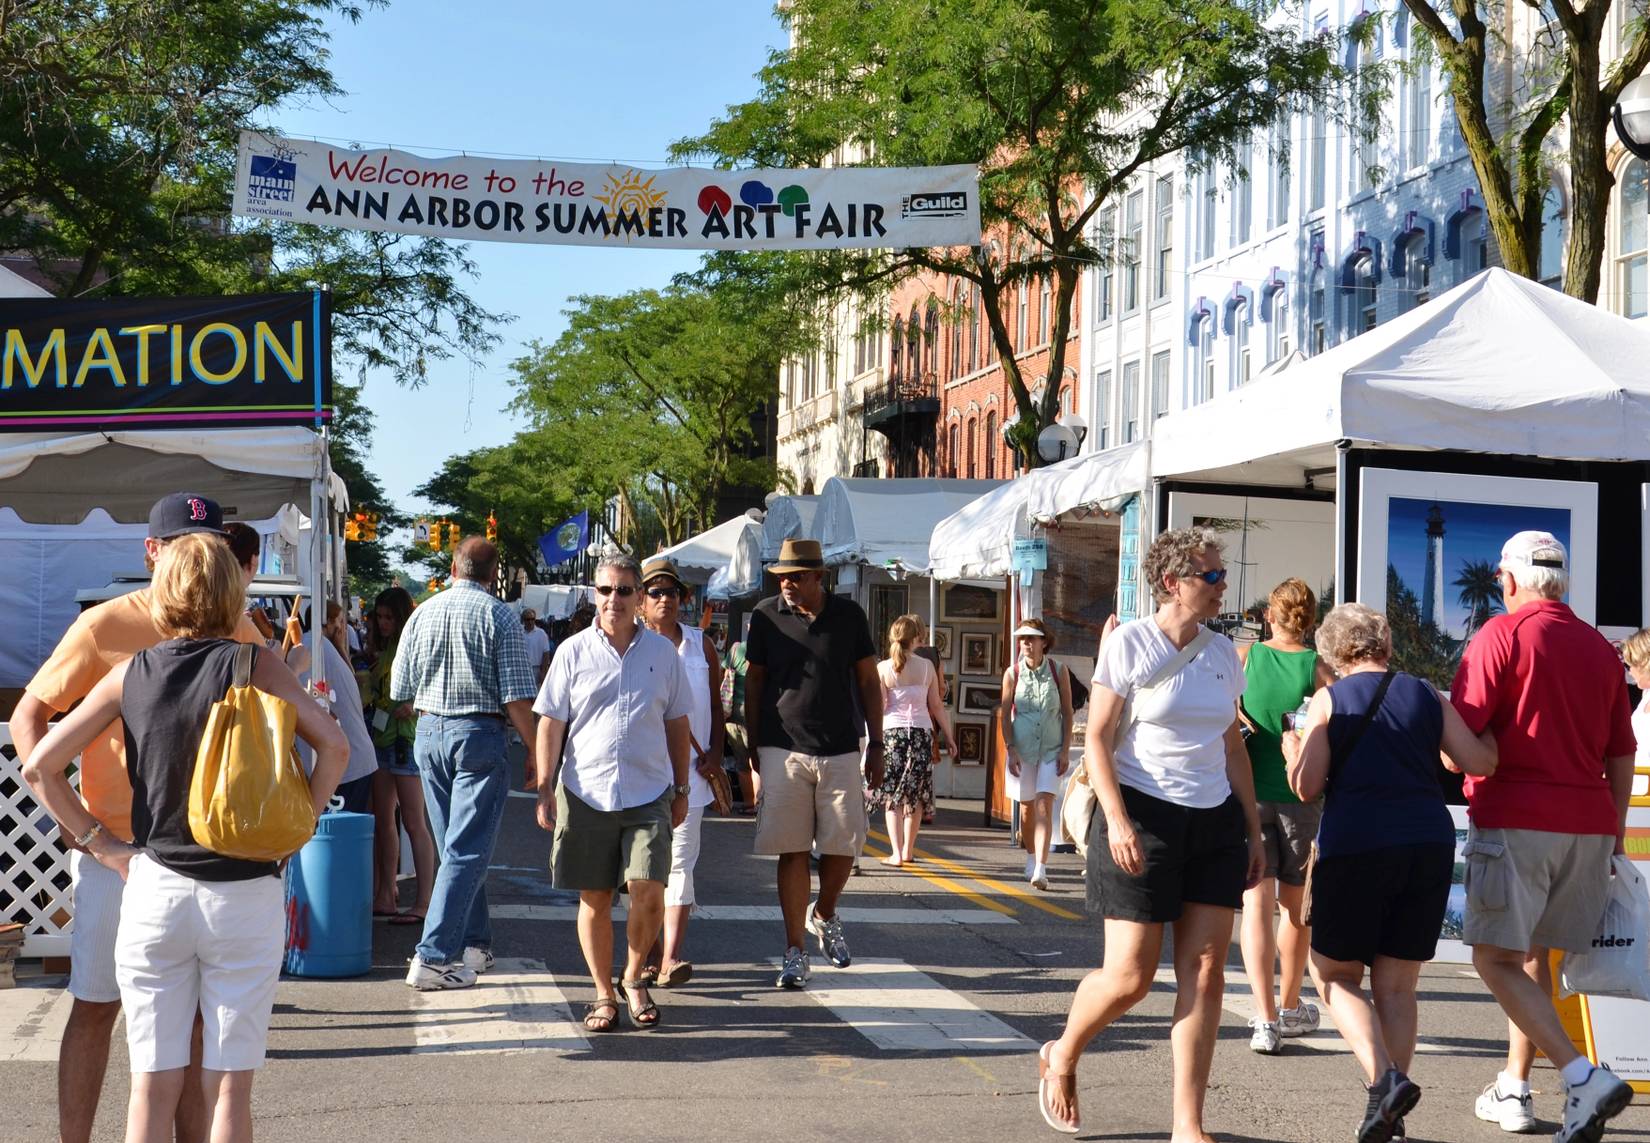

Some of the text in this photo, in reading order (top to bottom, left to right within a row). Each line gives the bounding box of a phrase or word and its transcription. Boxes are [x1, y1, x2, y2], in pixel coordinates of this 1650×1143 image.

[328, 151, 585, 197] Welcome to the
[249, 175, 294, 191] main
[247, 198, 266, 206] area
[248, 186, 294, 202] street
[902, 196, 910, 220] THE
[911, 196, 965, 210] Guild
[246, 207, 293, 218] association
[305, 184, 888, 240] ANN ARBOR SUMMER ART FAIR
[1, 320, 303, 389] MATION
[187, 498, 207, 520] B
[1591, 934, 1635, 948] rider
